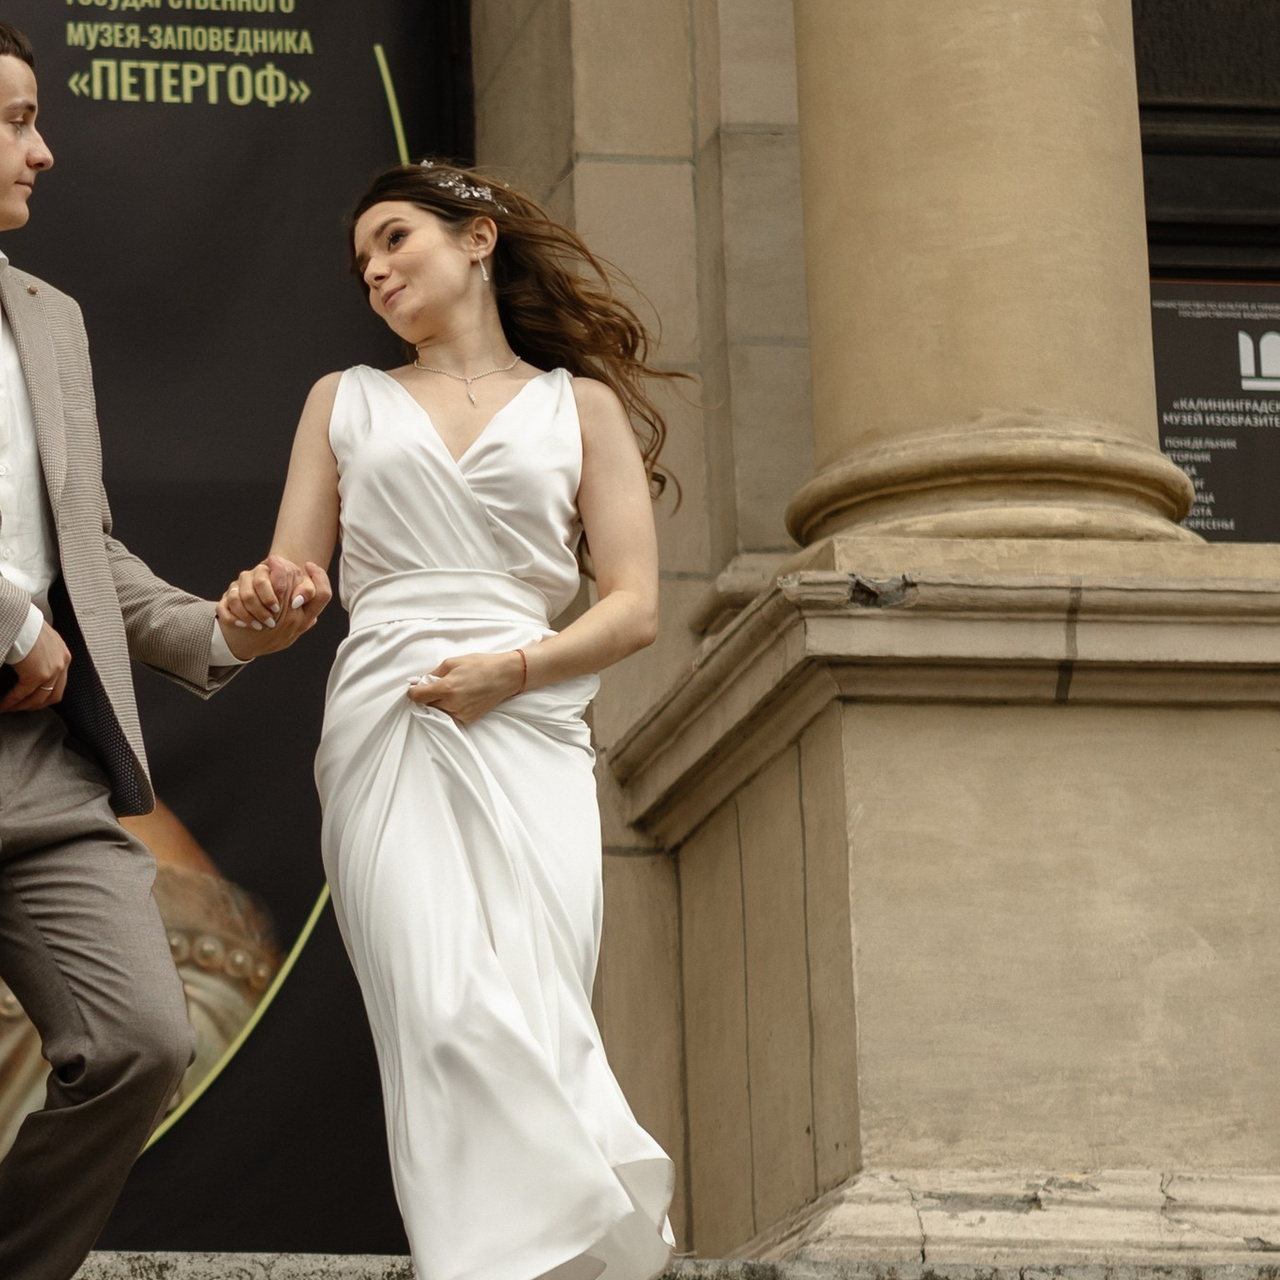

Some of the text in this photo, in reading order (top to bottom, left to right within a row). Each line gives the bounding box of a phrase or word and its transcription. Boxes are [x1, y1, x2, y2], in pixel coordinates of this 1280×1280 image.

[66, 22, 314, 56] МУЗЕЯ-ЗАПОВЕДНИКА
[67, 58, 312, 108] «ПЕТЕРГОФ»
[1163, 411, 1203, 426] МУЗЕЙ
